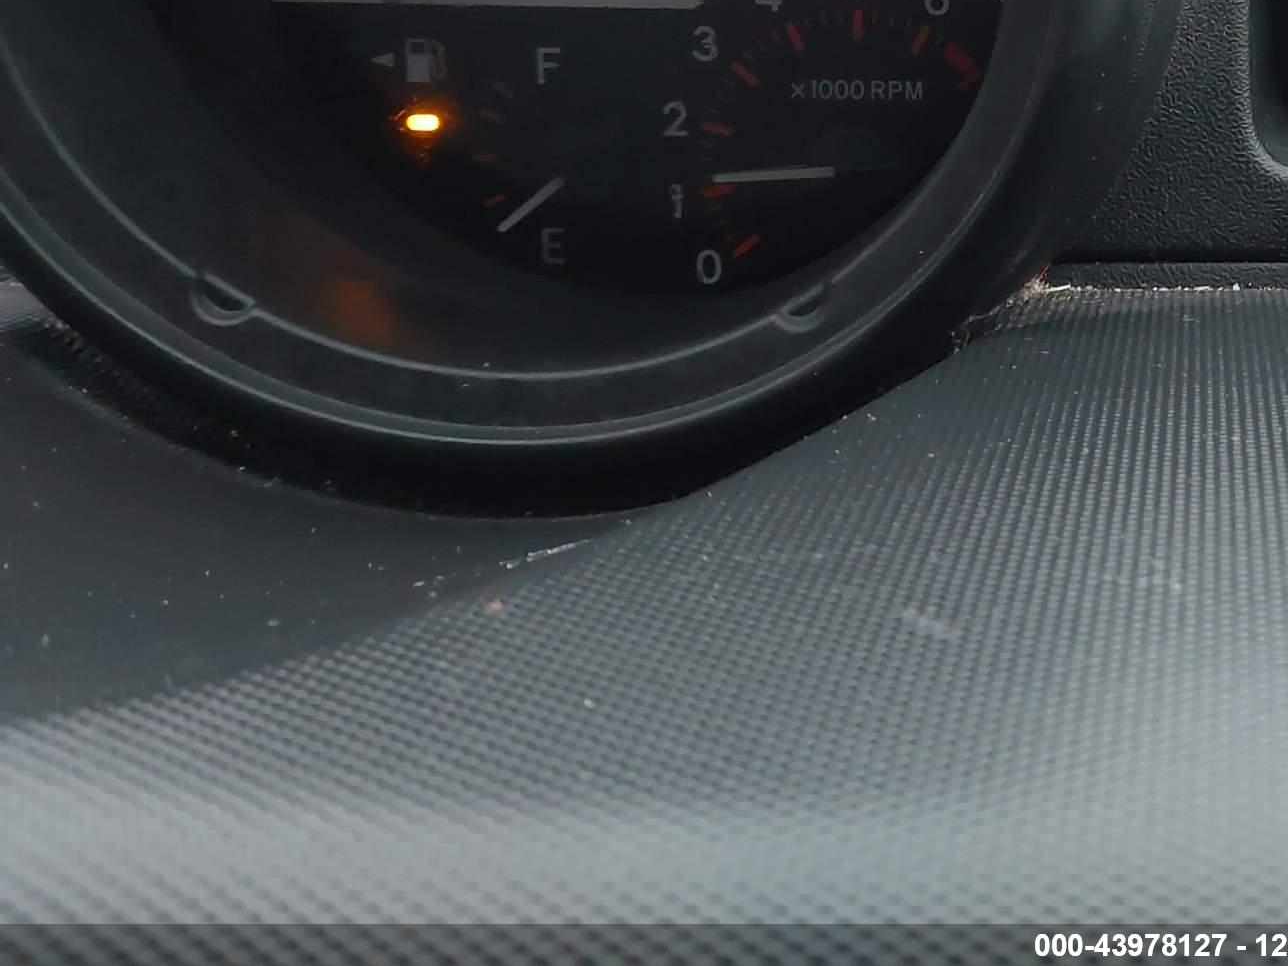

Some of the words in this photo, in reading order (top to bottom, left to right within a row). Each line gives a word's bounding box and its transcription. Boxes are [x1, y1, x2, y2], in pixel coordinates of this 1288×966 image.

[692, 26, 719, 61] 3
[536, 47, 561, 84] F
[871, 81, 923, 100] RPM
[662, 101, 688, 136] 2
[668, 183, 684, 218] 1
[542, 228, 566, 264] E
[697, 250, 722, 284] 0
